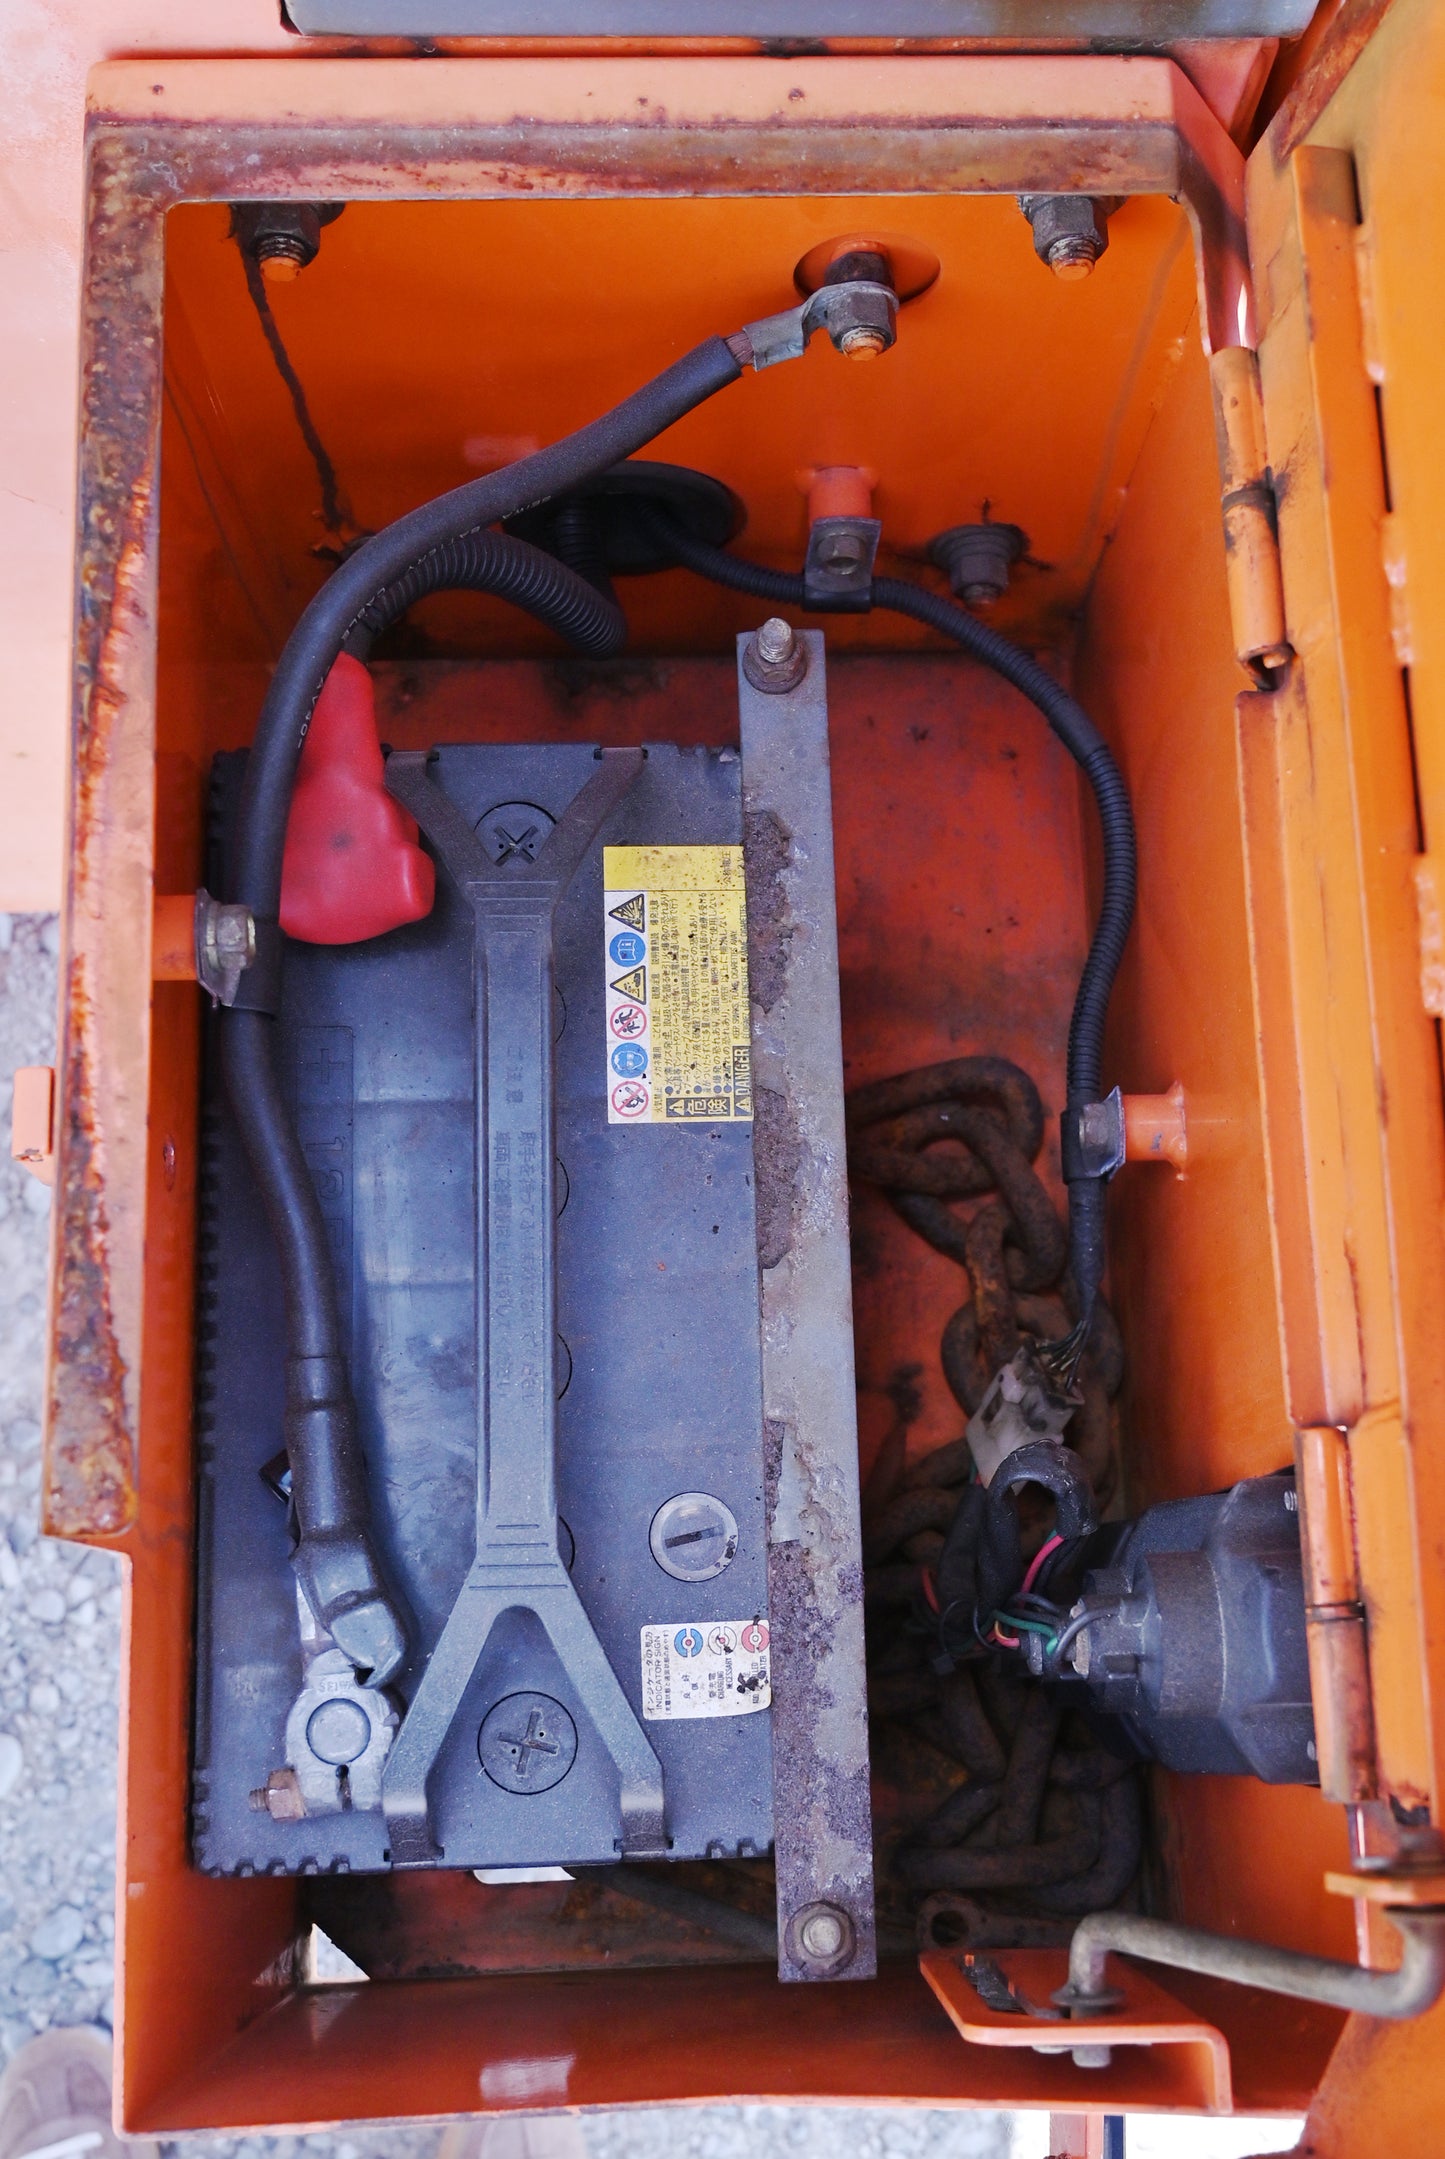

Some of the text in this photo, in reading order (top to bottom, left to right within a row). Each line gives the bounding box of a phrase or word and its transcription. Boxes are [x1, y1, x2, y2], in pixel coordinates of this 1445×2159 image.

[340, 586, 386, 641] CABLE
[722, 851, 731, 884] 公称電圧
[730, 948, 738, 979] CIGARETTES
[653, 1009, 661, 1038] こども禁止
[734, 1049, 750, 1095] DANGER
[688, 1098, 727, 1115] 危険
[645, 1632, 654, 1713] インジケータの見方
[708, 1673, 716, 1698] 要充電
